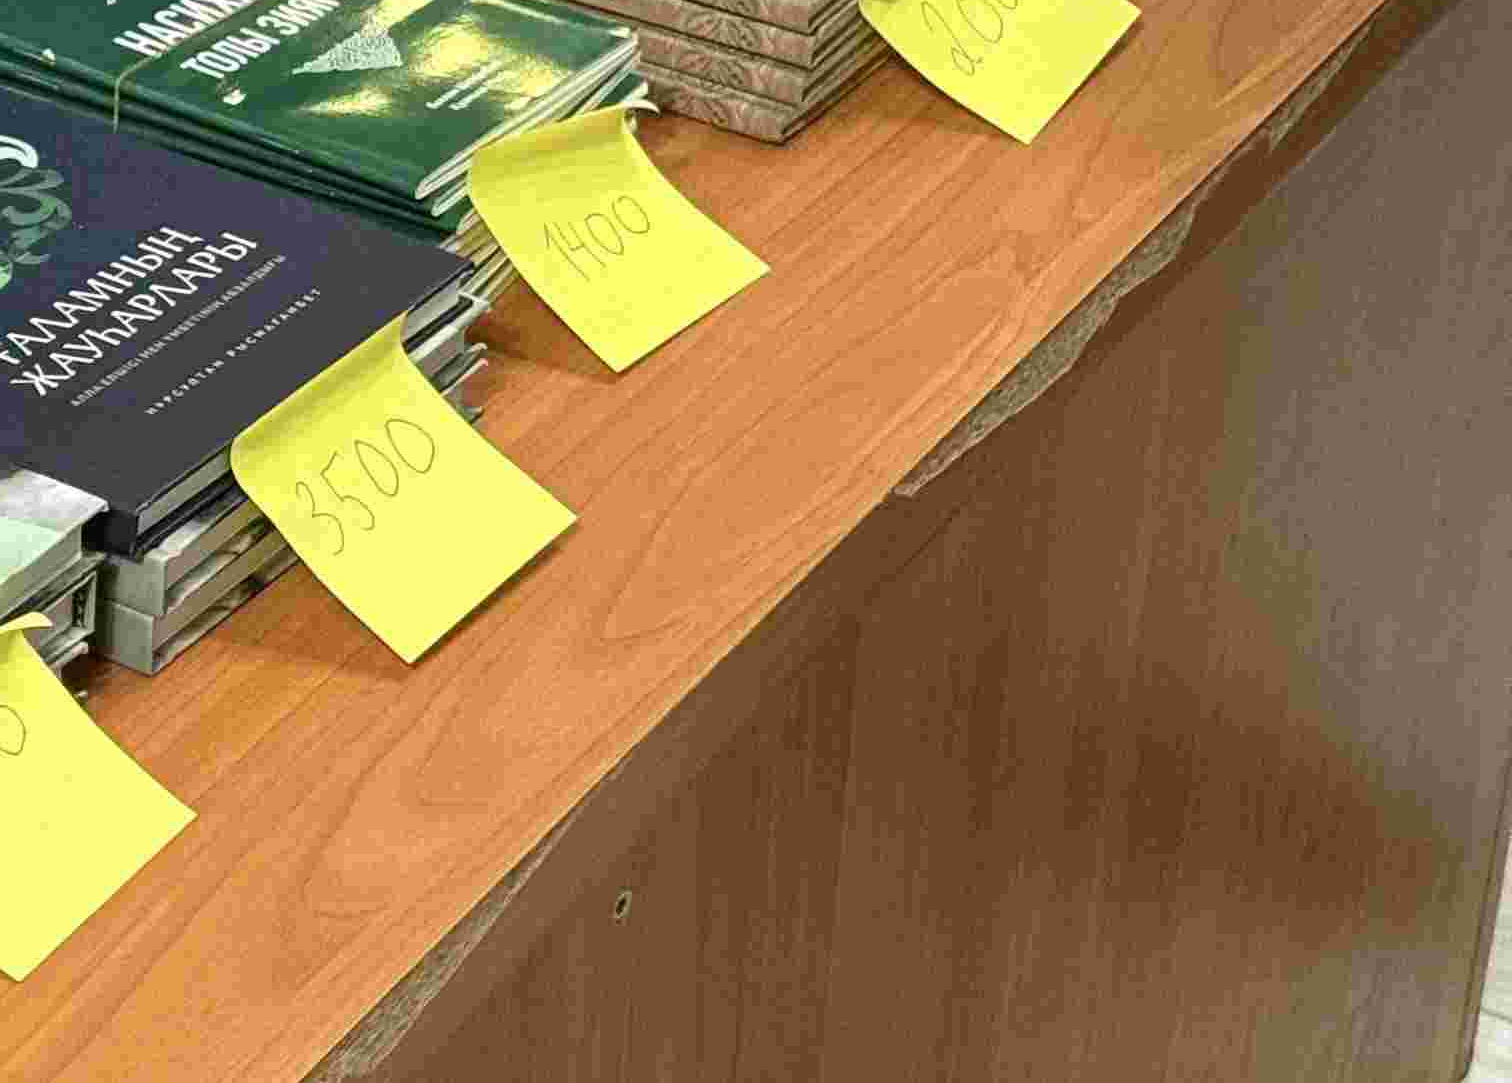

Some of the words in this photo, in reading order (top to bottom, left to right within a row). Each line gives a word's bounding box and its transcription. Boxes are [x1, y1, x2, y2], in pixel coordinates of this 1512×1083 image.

[179, 28, 281, 80] ТОЛЫ
[542, 194, 652, 283] 1400
[10, 231, 258, 397] ЖАУҺАРЛАРЫ
[293, 416, 437, 558] 3500
